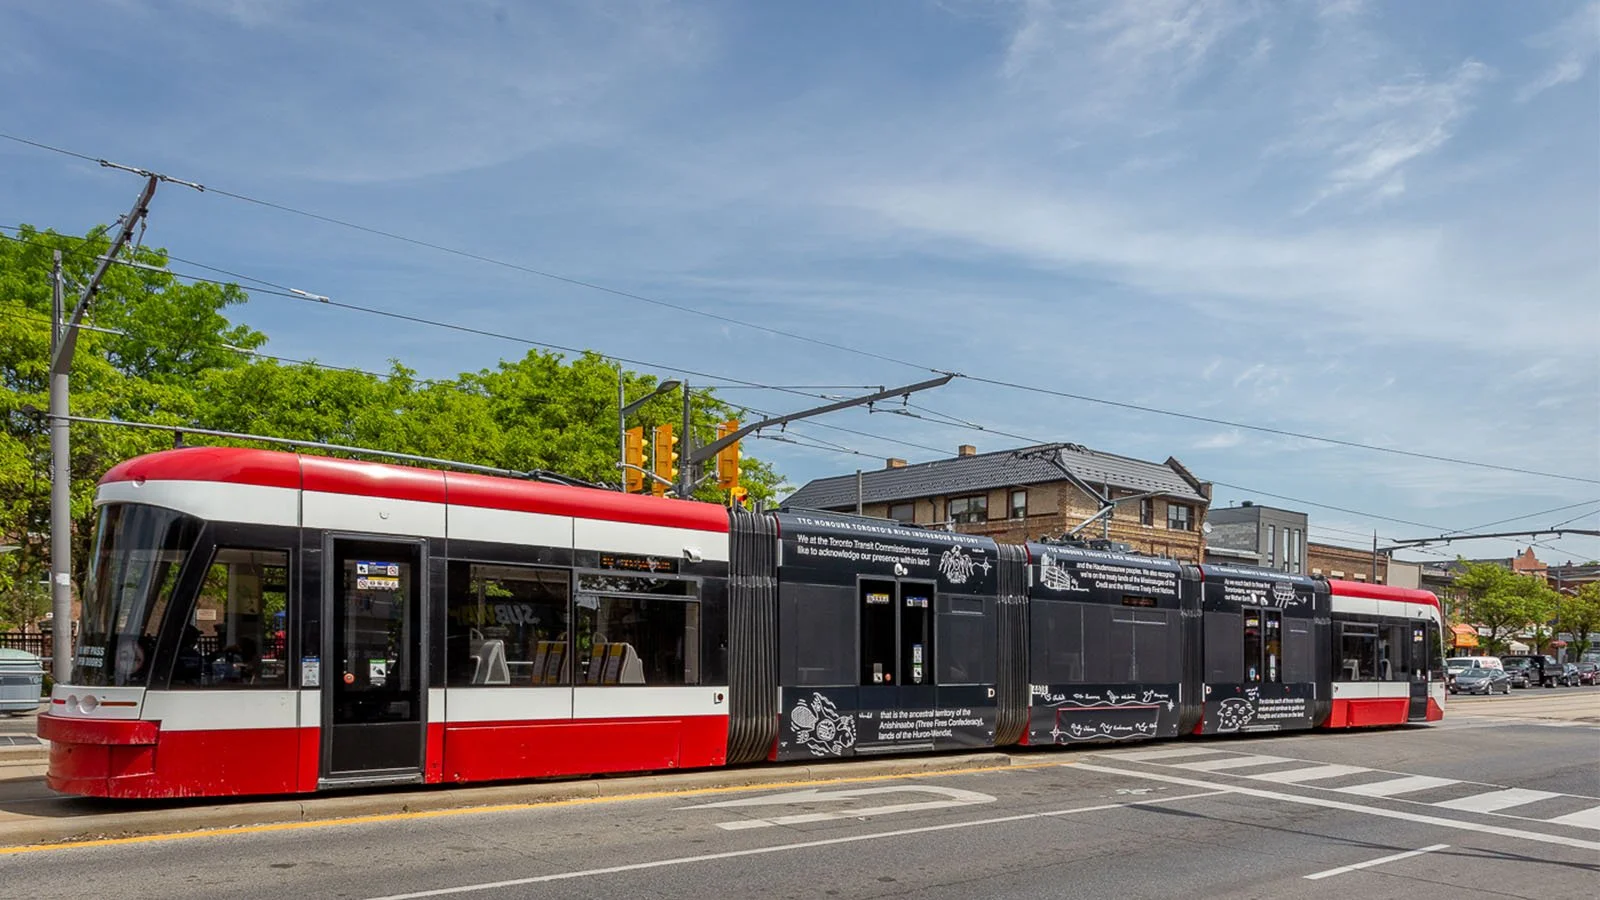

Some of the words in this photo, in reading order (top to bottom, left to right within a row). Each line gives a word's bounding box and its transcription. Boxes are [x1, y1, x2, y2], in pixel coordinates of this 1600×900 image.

[815, 520, 850, 530] HONOURS
[852, 524, 892, 534] TORONTO'S
[912, 531, 951, 542] INDIGENOUS
[952, 536, 979, 544] HISTORY
[797, 534, 809, 544] We
[810, 536, 816, 544] at
[818, 536, 828, 546] the
[829, 537, 854, 548] Toronto
[854, 540, 874, 550] Transit
[875, 542, 910, 552] Commission
[911, 548, 928, 556] would
[797, 545, 810, 555] like
[810, 547, 818, 556] to
[819, 548, 860, 561] acknowledge
[872, 554, 900, 563] presence
[900, 556, 916, 565] within
[918, 558, 930, 566] land
[1096, 580, 1108, 588] Credit
[988, 688, 996, 698] D
[880, 710, 892, 719] that
[892, 710, 898, 719] is
[899, 710, 908, 718] the
[909, 710, 934, 718] ancestral
[935, 709, 954, 718] territory
[879, 720, 914, 730] Anishinaabe
[916, 720, 933, 730] (Three
[934, 718, 948, 727] Fires
[878, 731, 894, 740] lands
[896, 731, 902, 739] of
[902, 731, 912, 739] the
